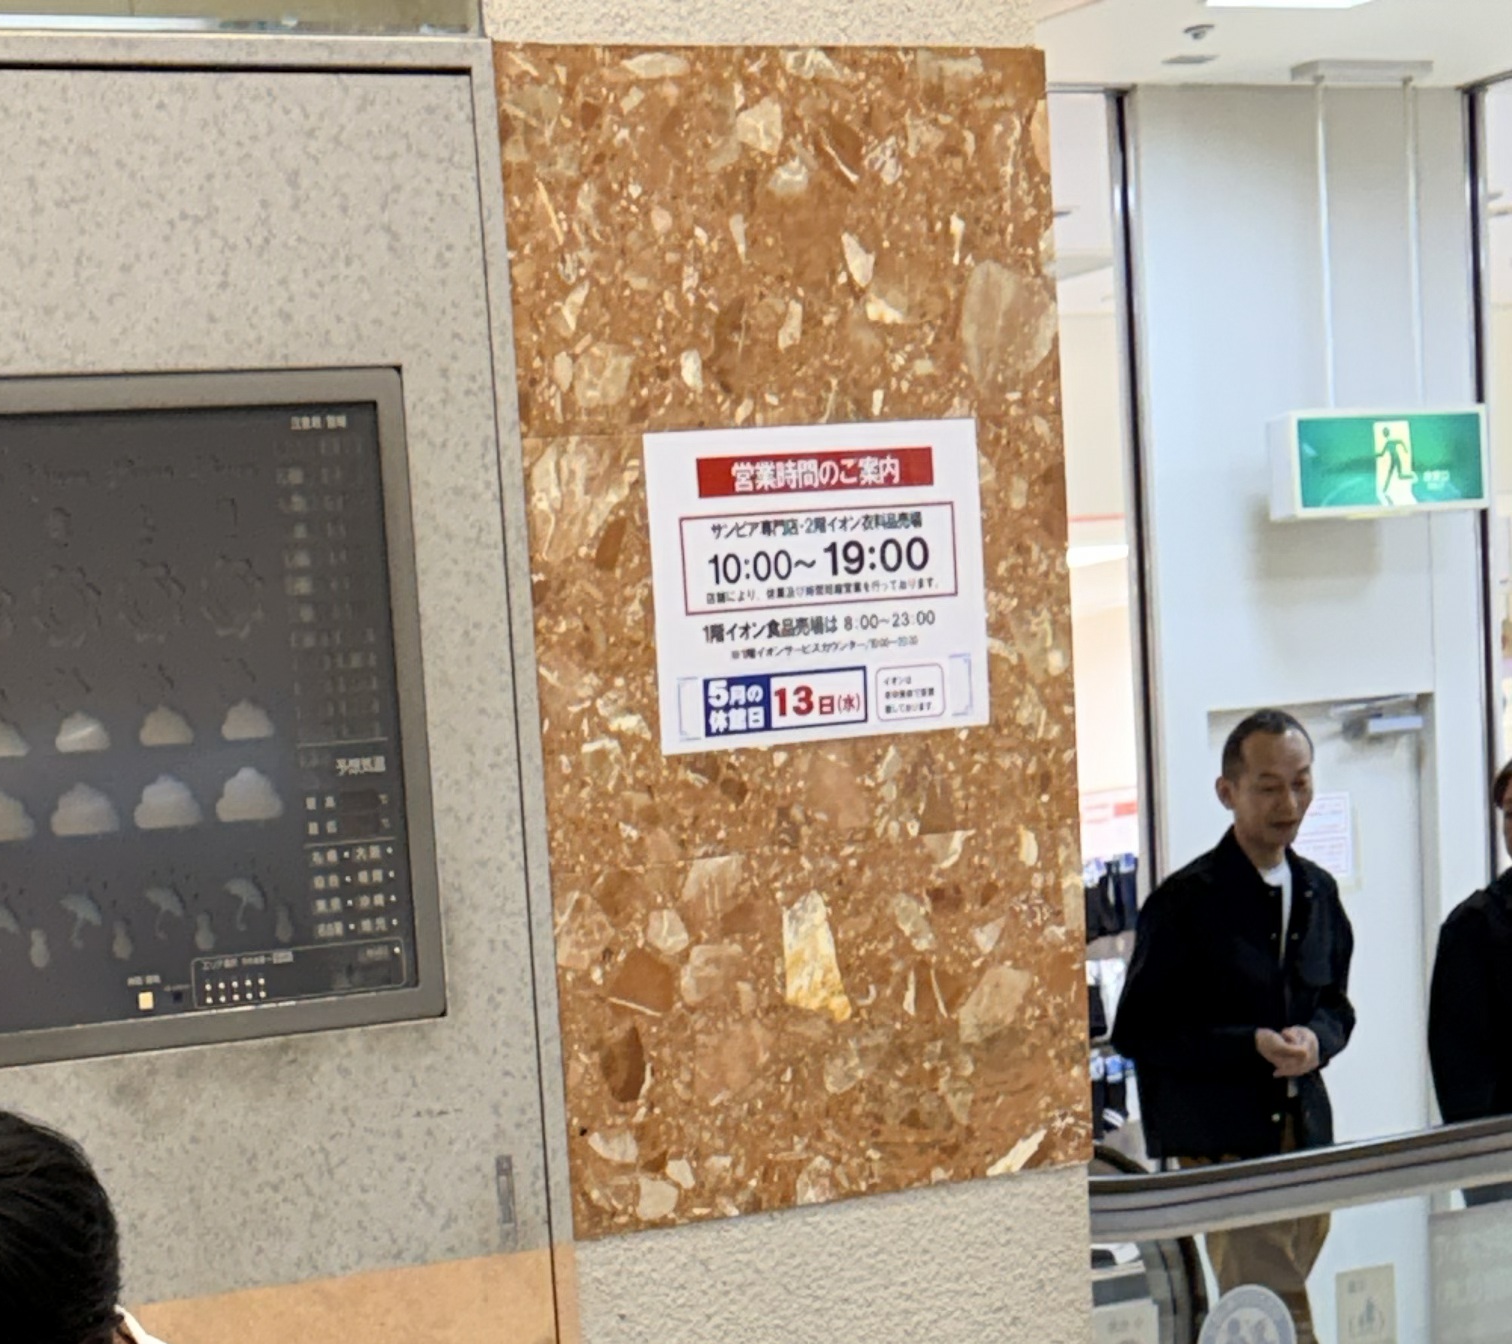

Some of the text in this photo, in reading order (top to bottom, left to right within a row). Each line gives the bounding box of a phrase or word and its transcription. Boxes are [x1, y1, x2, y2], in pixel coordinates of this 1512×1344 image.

[731, 456, 900, 491] 営業時間のご案内
[708, 680, 764, 708] 5月の
